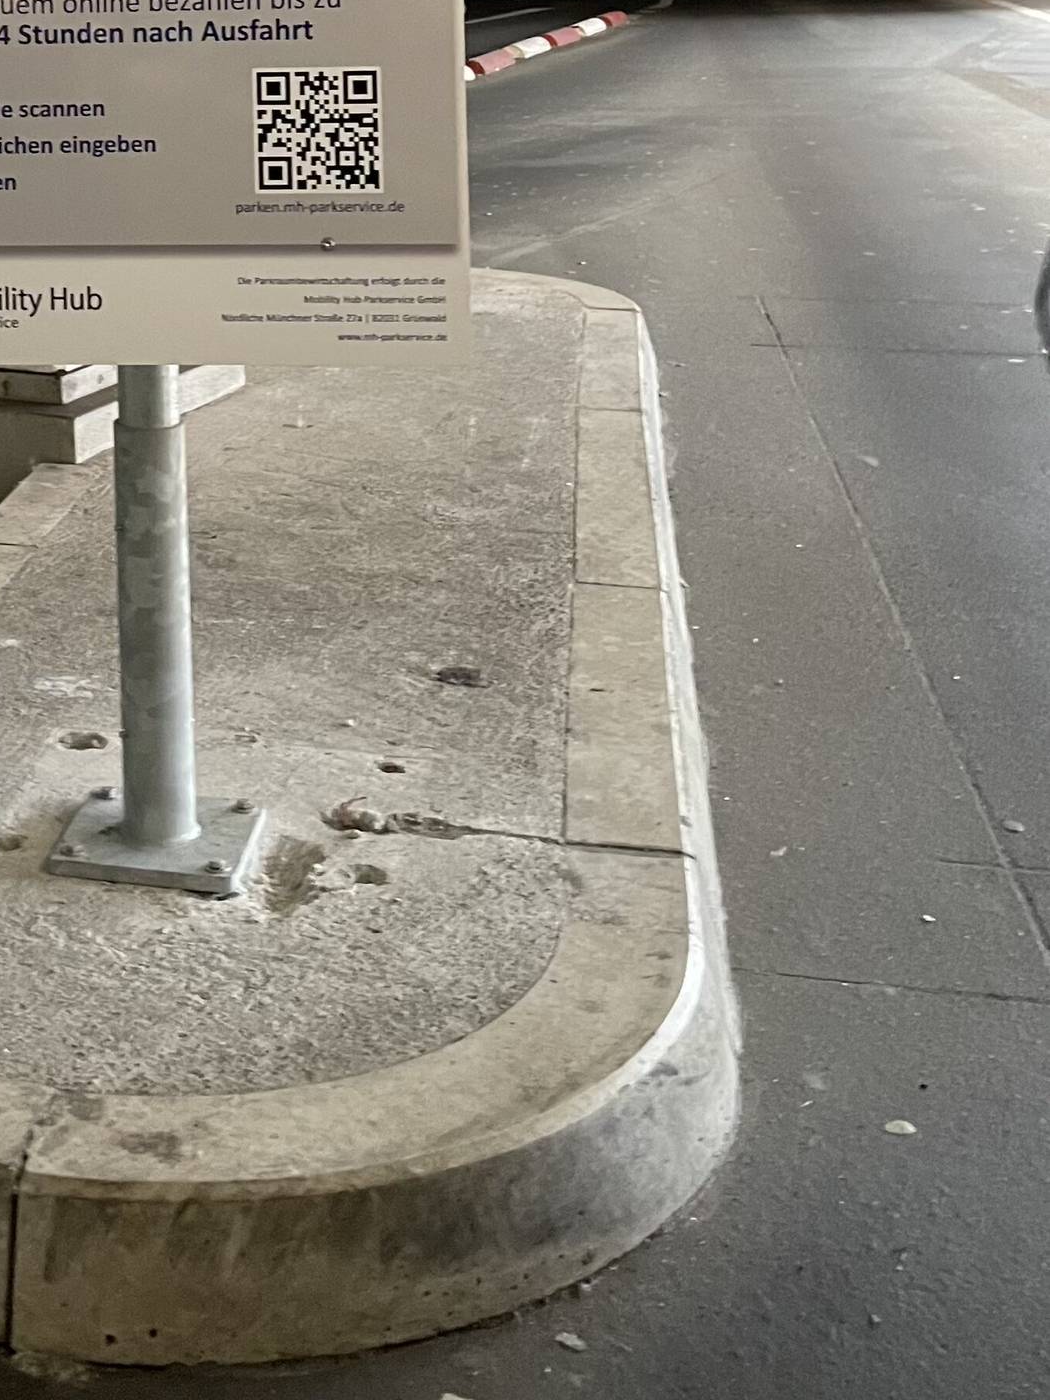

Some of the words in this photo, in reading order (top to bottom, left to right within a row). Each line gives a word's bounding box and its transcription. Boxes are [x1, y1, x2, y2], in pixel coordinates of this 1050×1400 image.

[17, 21, 124, 45] Stunden
[133, 20, 193, 43] nach
[201, 18, 314, 42] Ausfahrt
[18, 101, 106, 120] scannen
[59, 134, 157, 158] eingeben
[235, 200, 405, 215] parken.mh-parkservice.de
[50, 285, 103, 311] Hub
